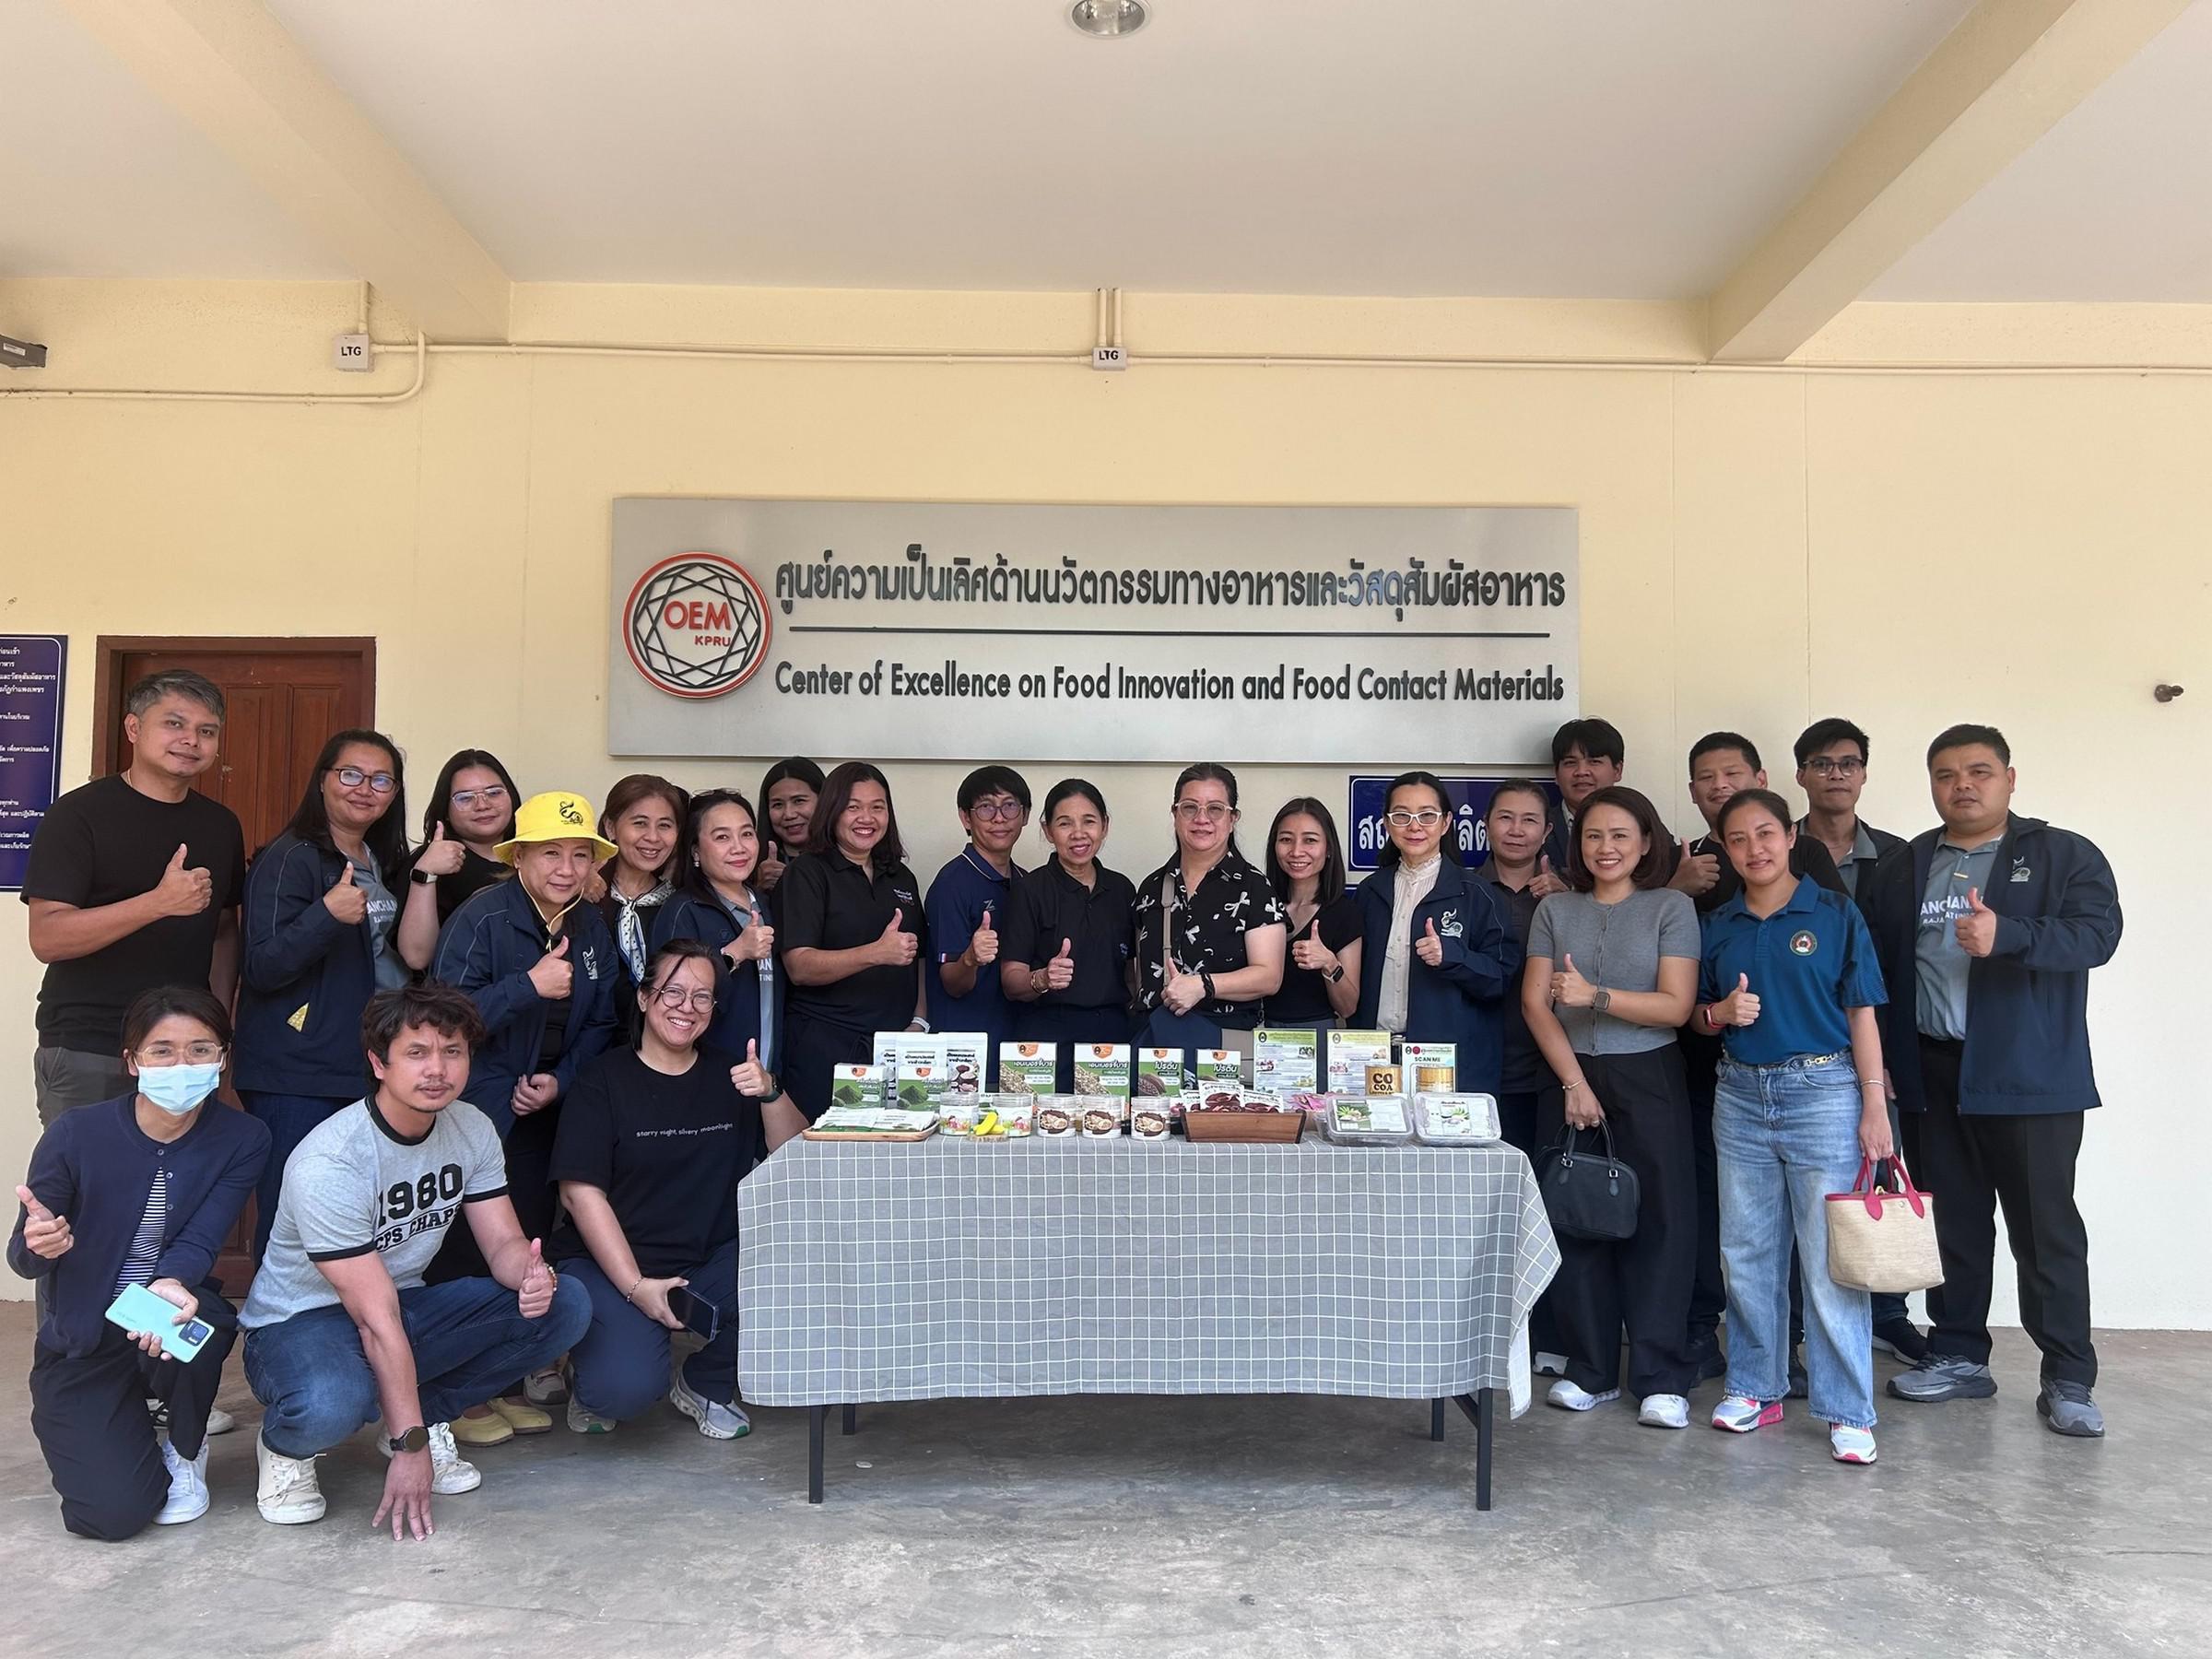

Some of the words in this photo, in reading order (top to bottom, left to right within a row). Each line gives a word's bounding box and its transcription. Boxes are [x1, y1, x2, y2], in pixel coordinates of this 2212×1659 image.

[341, 346, 362, 357] LTG
[1099, 349, 1119, 360] LTG
[775, 543, 1566, 622] ศูนย์ความเป็นเลิศด้านนวัตกรรมทางอาหารและวัสดุสัมผัสอาหาร
[664, 600, 732, 631] OEM
[694, 634, 731, 647] KPRU
[775, 661, 853, 695] Center
[858, 659, 883, 696] of
[891, 660, 1011, 698] Excellence
[1018, 674, 1046, 699] on
[1053, 662, 1111, 699] Food
[1118, 665, 1234, 700] Innovation
[1241, 664, 1285, 700] and
[1293, 664, 1351, 700] Food
[1357, 667, 1447, 700] Contact
[1453, 664, 1564, 701] Materials
[1372, 1073, 1394, 1084] CO
[378, 1162, 464, 1230] 1980
